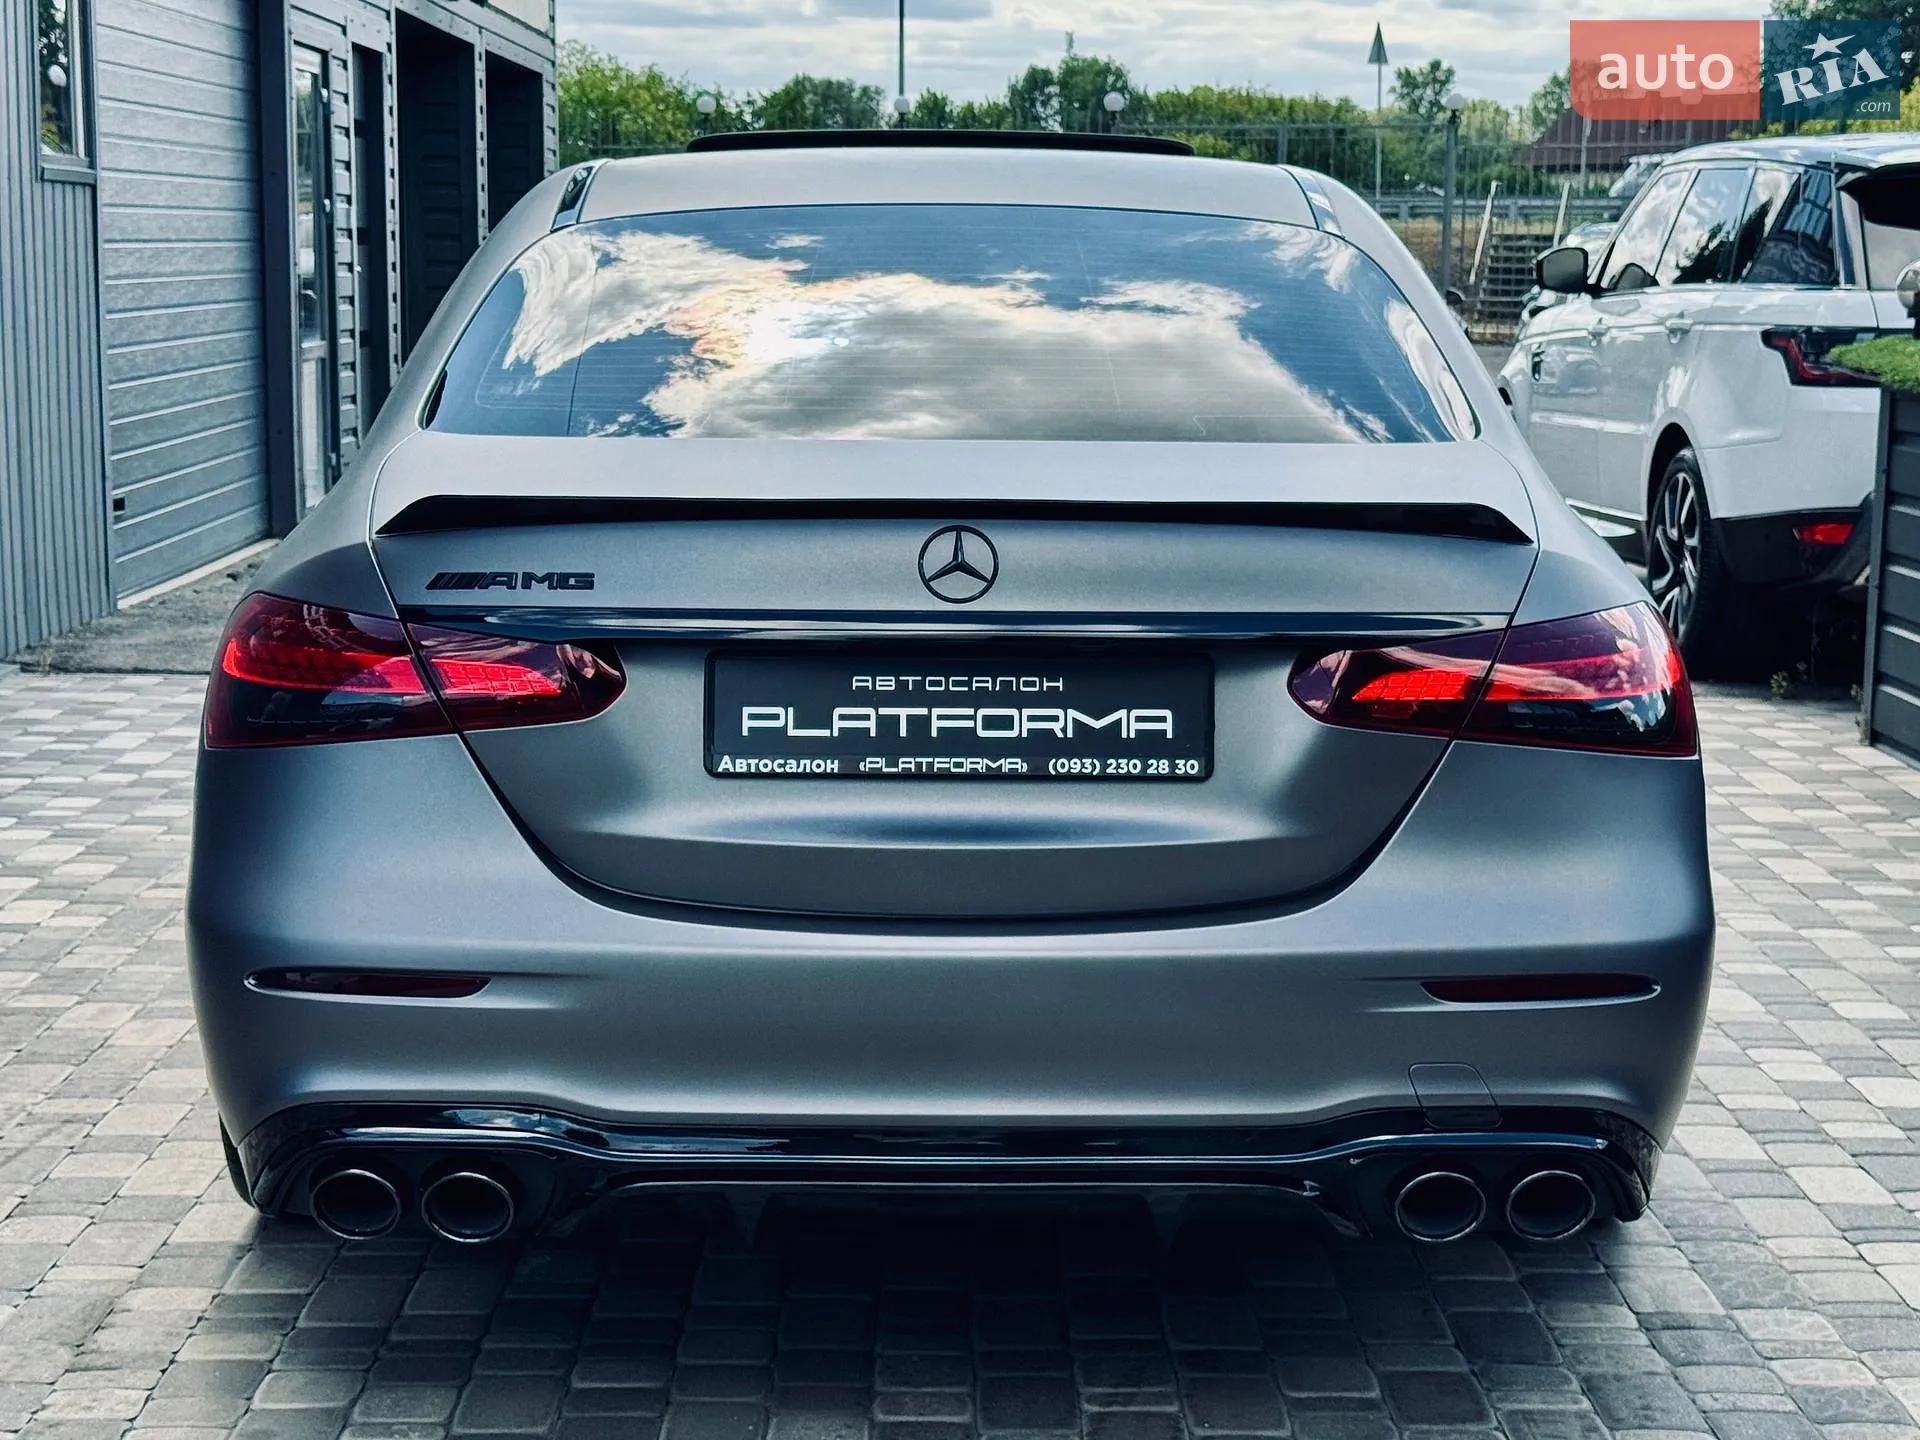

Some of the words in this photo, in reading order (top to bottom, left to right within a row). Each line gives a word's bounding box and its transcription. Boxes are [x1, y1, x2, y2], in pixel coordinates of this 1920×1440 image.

[476, 572, 596, 590] AMG
[852, 675, 1064, 692] АВТОСАЛОН
[741, 706, 1173, 739] PLATFORMA
[717, 755, 839, 774] Автосалон
[858, 757, 1029, 774] «PLATFORMA»
[1048, 757, 1101, 776] (093)
[1105, 758, 1142, 774] 230
[1146, 759, 1170, 774] 28
[1174, 759, 1200, 775] 30
